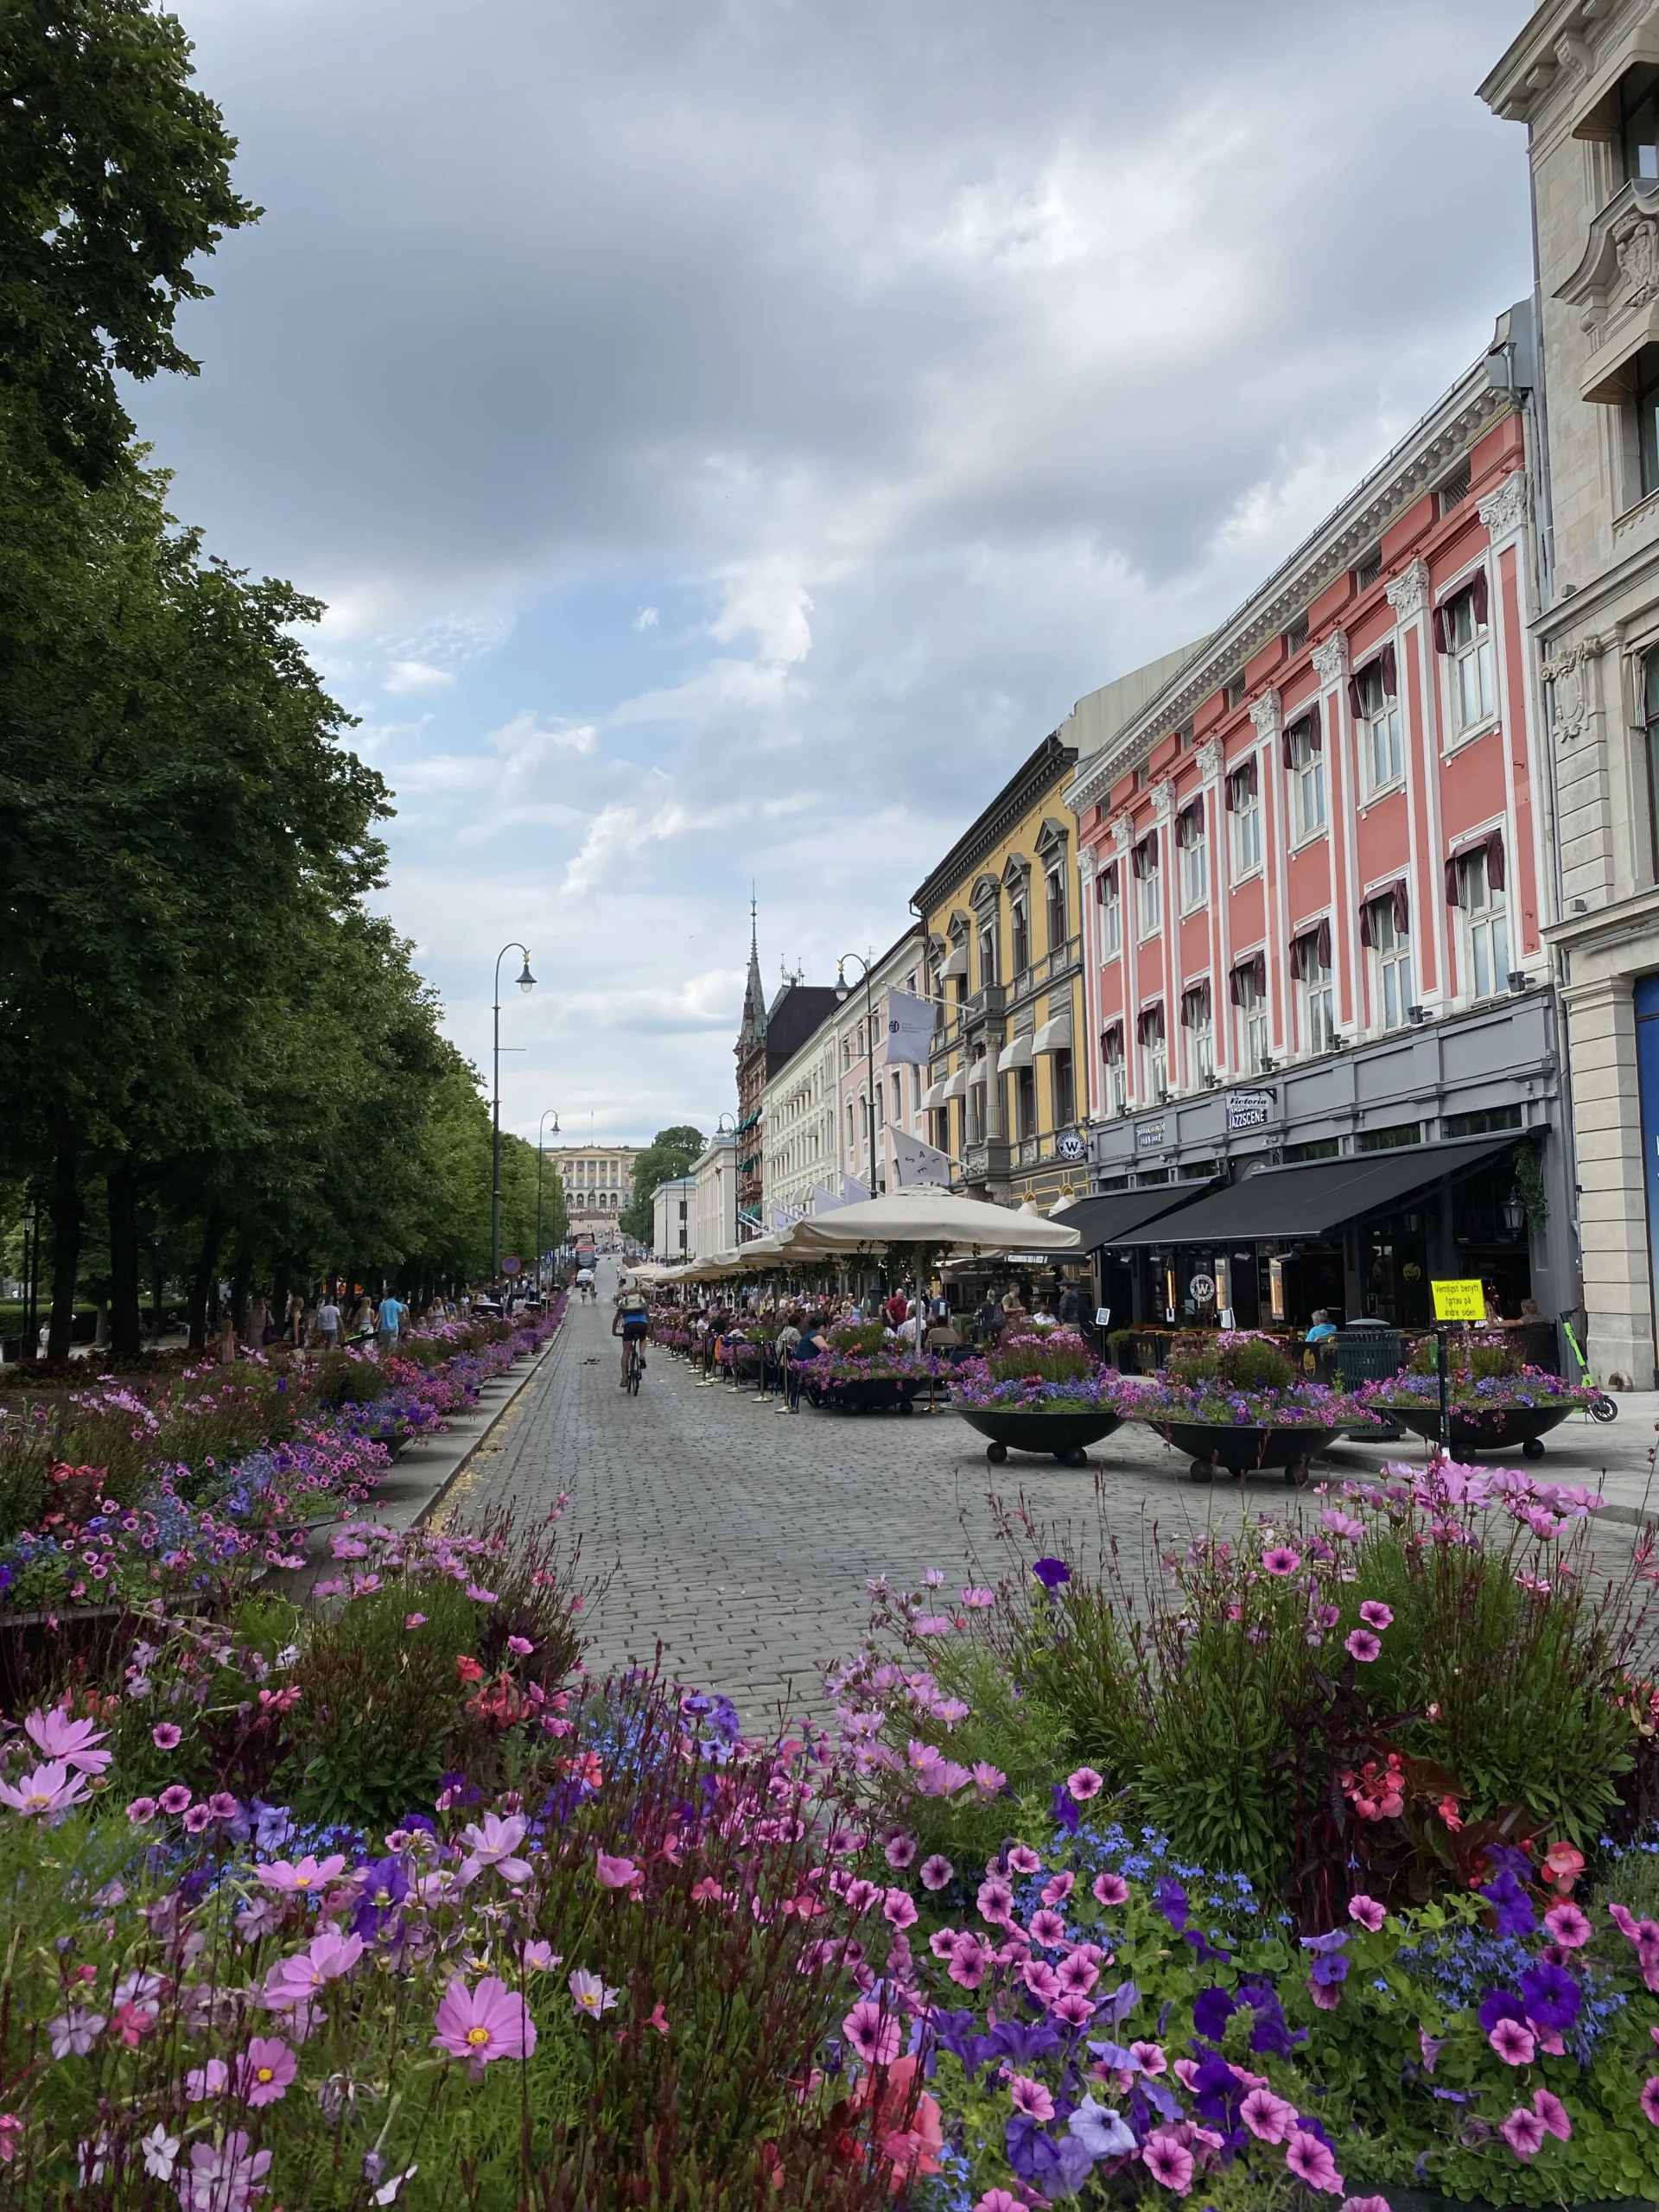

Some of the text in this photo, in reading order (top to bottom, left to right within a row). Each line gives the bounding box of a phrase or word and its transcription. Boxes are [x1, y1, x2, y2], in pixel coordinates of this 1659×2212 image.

[1229, 1109, 1264, 1128] JAZZSCENE
[1065, 1141, 1079, 1152] W
[1196, 1283, 1209, 1294] W
[1460, 1284, 1479, 1294] benytt
[1464, 1296, 1471, 1306] på
